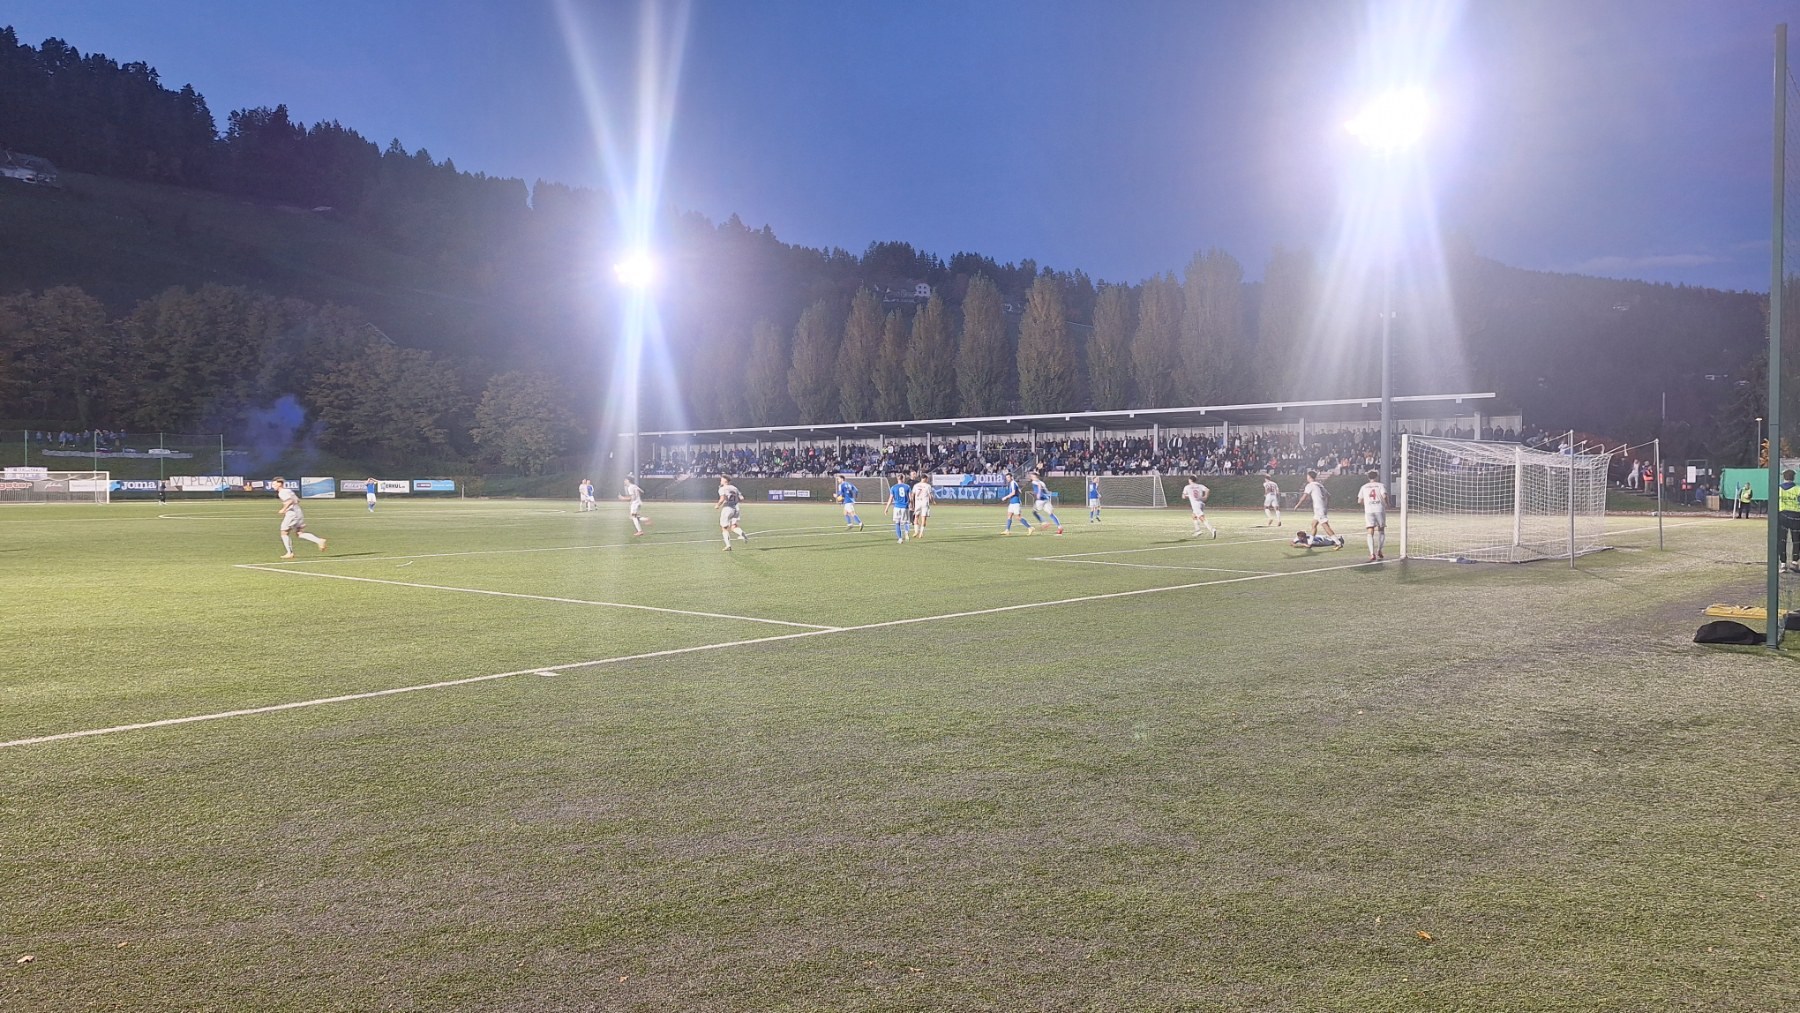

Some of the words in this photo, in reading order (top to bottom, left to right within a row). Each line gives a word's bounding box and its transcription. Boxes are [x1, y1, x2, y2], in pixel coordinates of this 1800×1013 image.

[898, 487, 905, 497] 8
[917, 489, 922, 497] 7
[1369, 489, 1376, 500] 4
